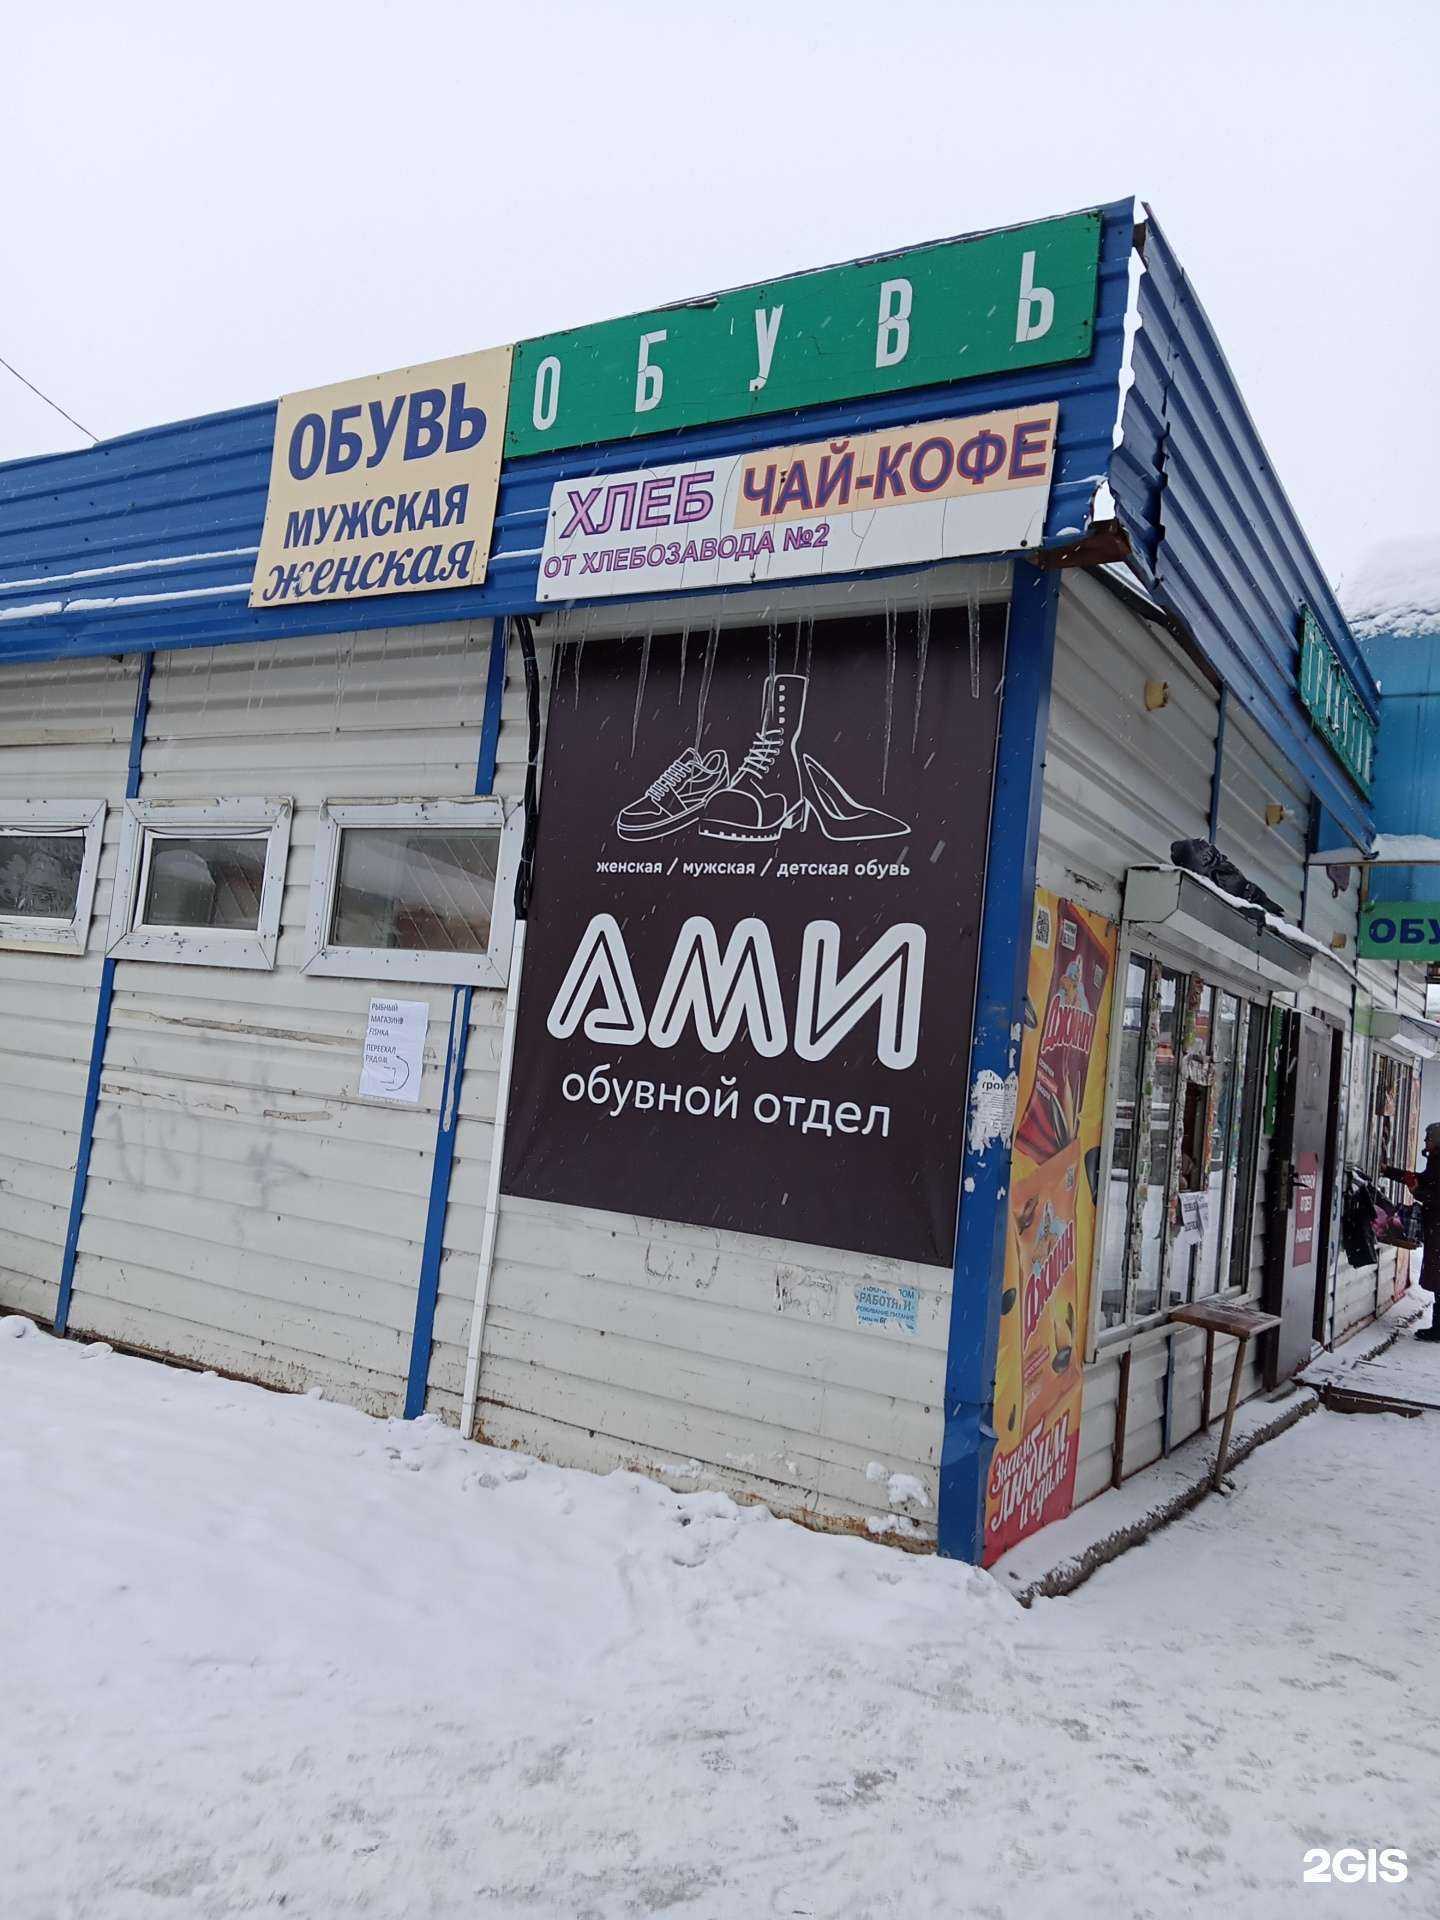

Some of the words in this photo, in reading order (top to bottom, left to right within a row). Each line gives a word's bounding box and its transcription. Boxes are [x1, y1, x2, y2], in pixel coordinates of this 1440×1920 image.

[532, 250, 1056, 431] ОБУВЬ
[287, 382, 488, 481] ОБУВЬ
[558, 469, 716, 540] ХЛЕБ
[742, 417, 1053, 517] ЧАЙ-КОФЕ
[282, 483, 470, 550] МУЖСКАЯ
[261, 539, 476, 602] женская
[543, 553, 578, 579] ОТ
[579, 528, 776, 575] ХЛЕБОЗАВОДА
[782, 523, 831, 550] №2
[596, 859, 663, 875] женская
[682, 859, 756, 877] мужская
[776, 860, 850, 878] детская
[853, 858, 911, 878] обувь
[371, 1002, 399, 1013] РЫБНЫЙ
[546, 912, 928, 1071] АМИ
[366, 1043, 397, 1055] ПЕРЕЕХАЛ
[561, 1062, 740, 1120] обувной
[752, 1092, 892, 1138] отдел
